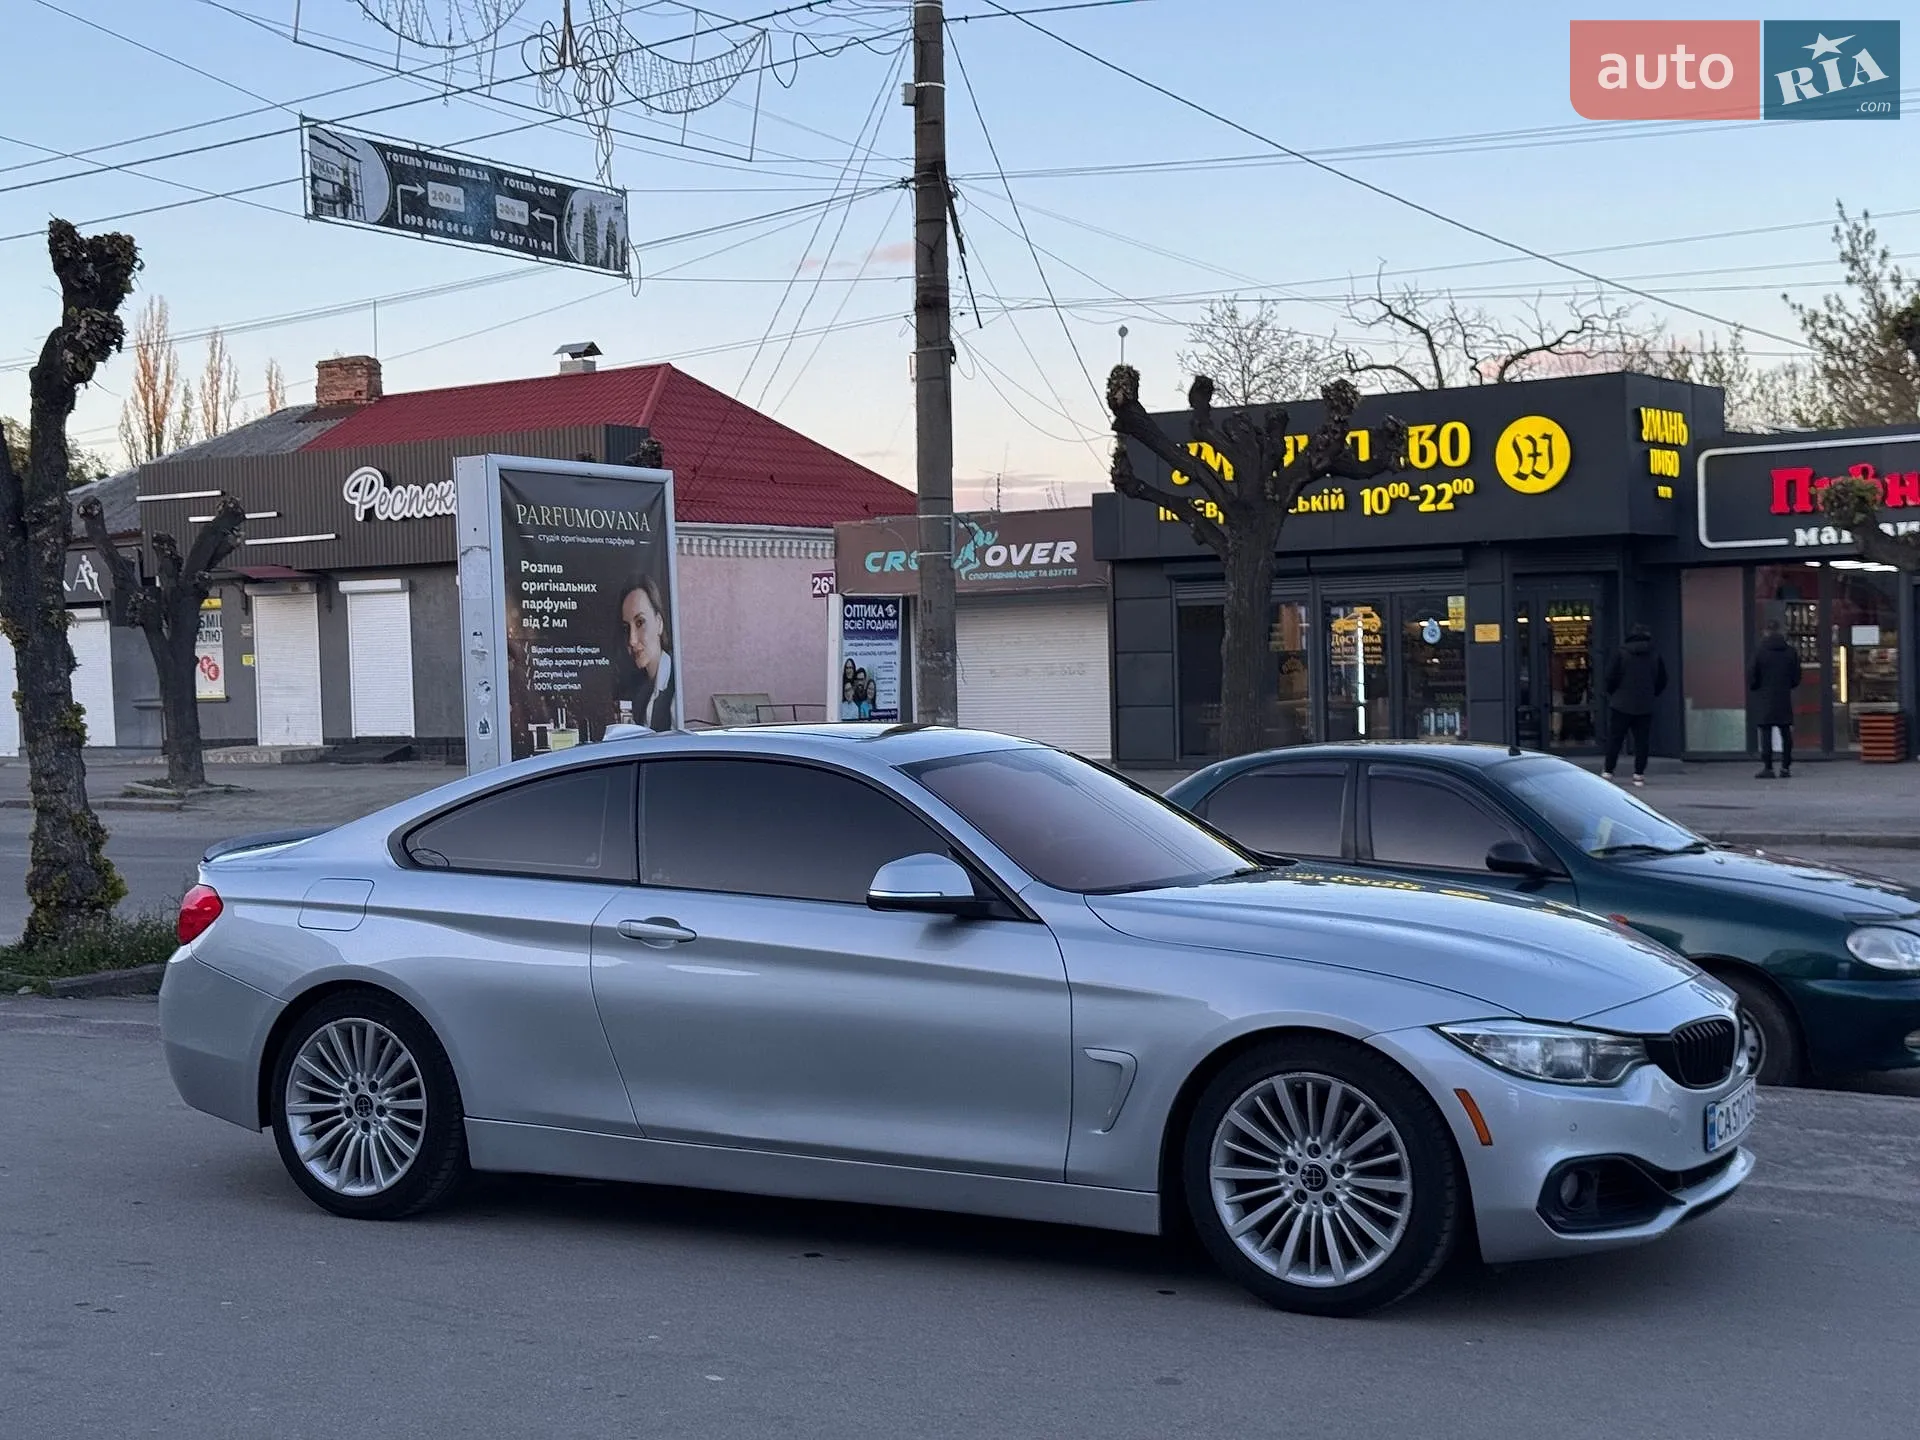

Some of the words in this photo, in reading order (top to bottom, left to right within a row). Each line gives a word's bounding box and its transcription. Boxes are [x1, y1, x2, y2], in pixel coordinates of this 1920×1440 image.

[386, 151, 422, 168] ГОТЕЛЬ
[424, 159, 456, 174] УМАНЬ
[458, 167, 491, 182] ПЛАЗА
[503, 176, 536, 193] ГОТЕЛЬ
[431, 190, 451, 204] 200
[403, 214, 424, 227] 098
[1640, 407, 1688, 446] УМАНЬ
[343, 466, 457, 521] Респек
[516, 504, 651, 532] PARFUMOVANA
[521, 560, 563, 574] Розпив
[521, 579, 597, 594] оригінальних
[522, 597, 578, 613] парфумів
[844, 604, 885, 618] ОПТИКА
[522, 615, 540, 629] від
[542, 615, 550, 628] 2
[552, 618, 568, 628] мл
[844, 618, 866, 630] ВСІЄЇ
[866, 619, 897, 631] РОДИНИ
